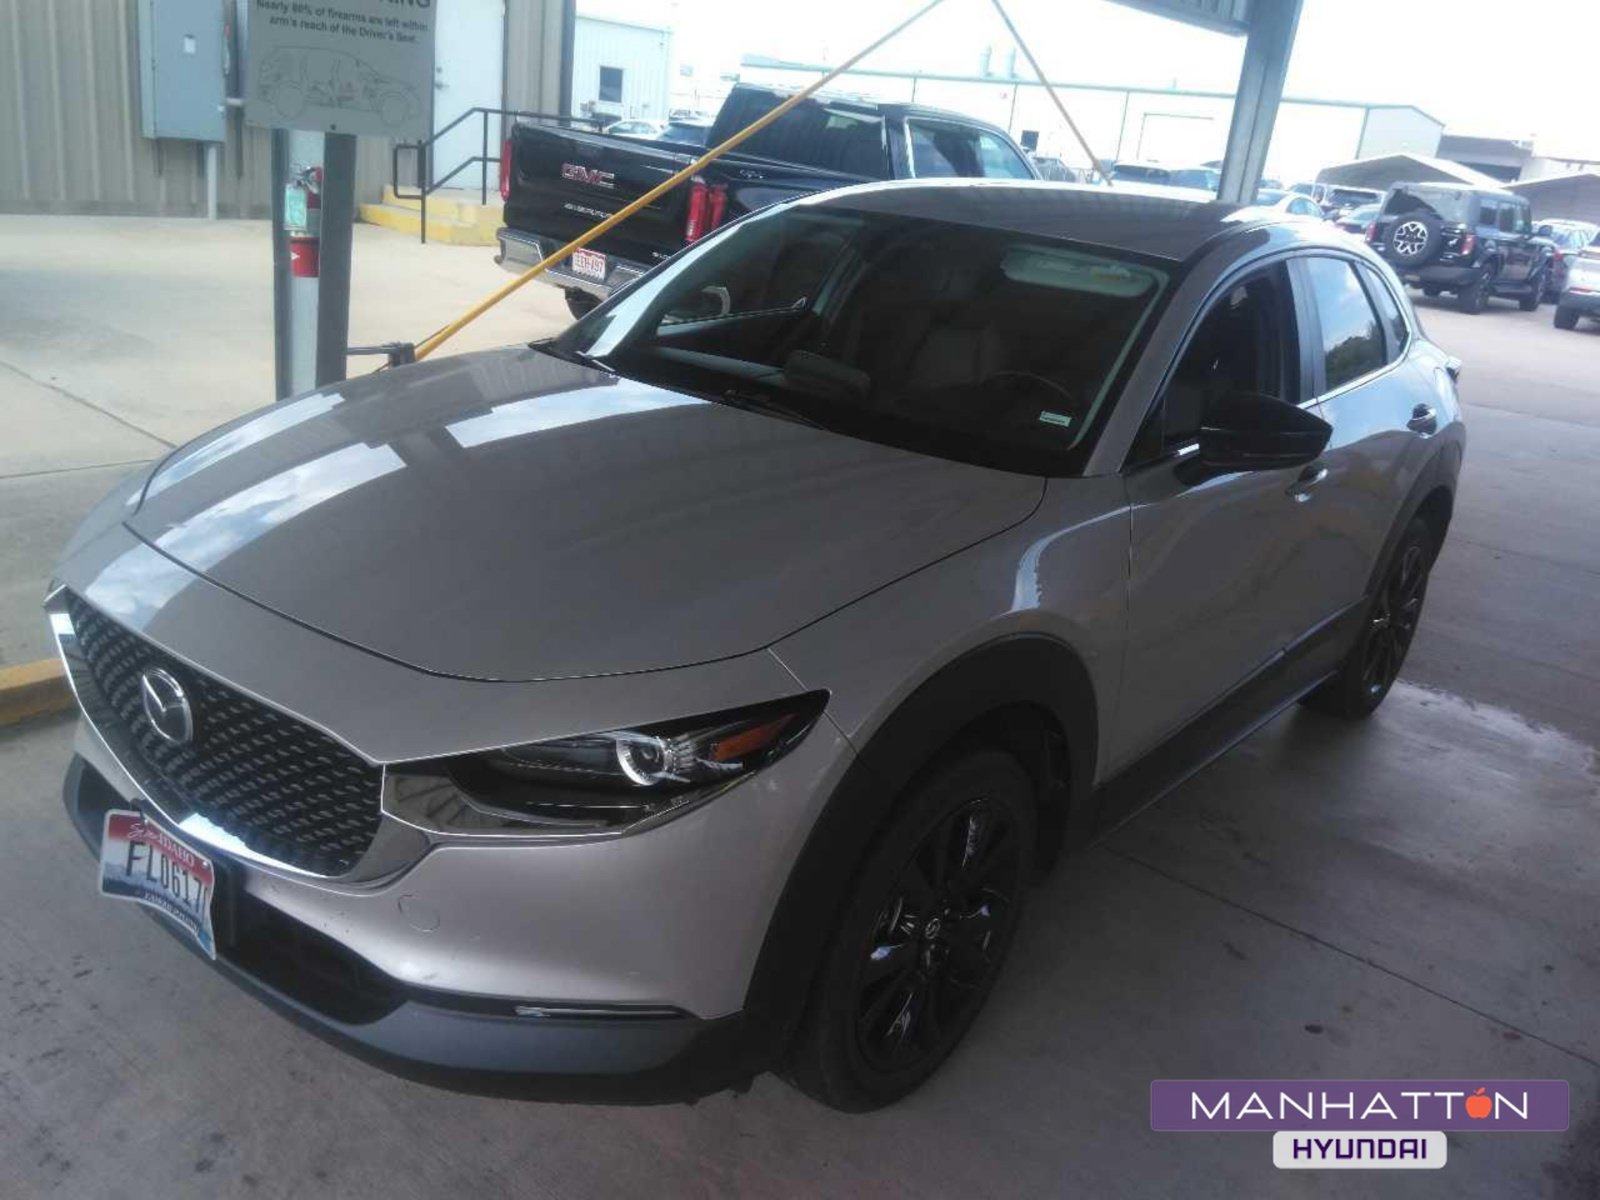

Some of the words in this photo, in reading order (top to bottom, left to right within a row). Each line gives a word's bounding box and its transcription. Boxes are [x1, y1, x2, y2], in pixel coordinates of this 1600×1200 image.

[269, 15, 298, 27] arm's
[300, 19, 327, 31] reach
[330, 22, 340, 33] of
[341, 24, 357, 36] the
[359, 26, 394, 40] Driver's
[315, 7, 326, 17] of
[328, 8, 366, 23] firearms
[561, 163, 615, 190] GMC
